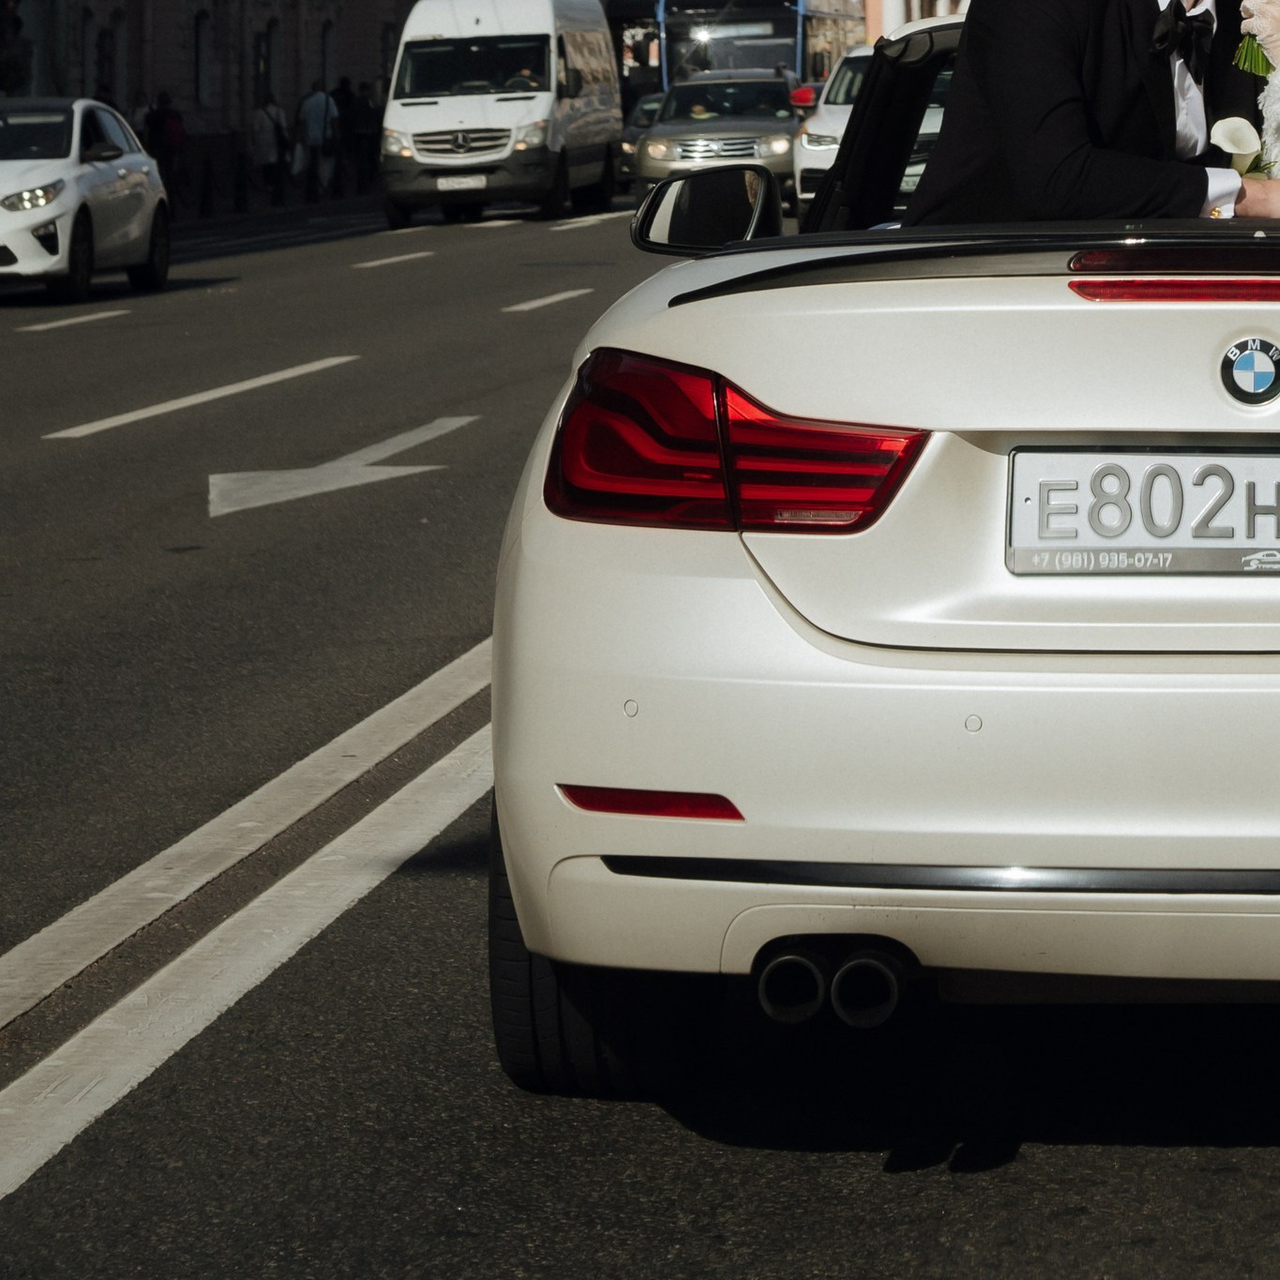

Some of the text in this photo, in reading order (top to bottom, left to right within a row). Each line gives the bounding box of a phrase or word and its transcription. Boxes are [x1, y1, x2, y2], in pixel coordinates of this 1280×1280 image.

[1031, 551, 1173, 571] +7 (981) 935-07-17
